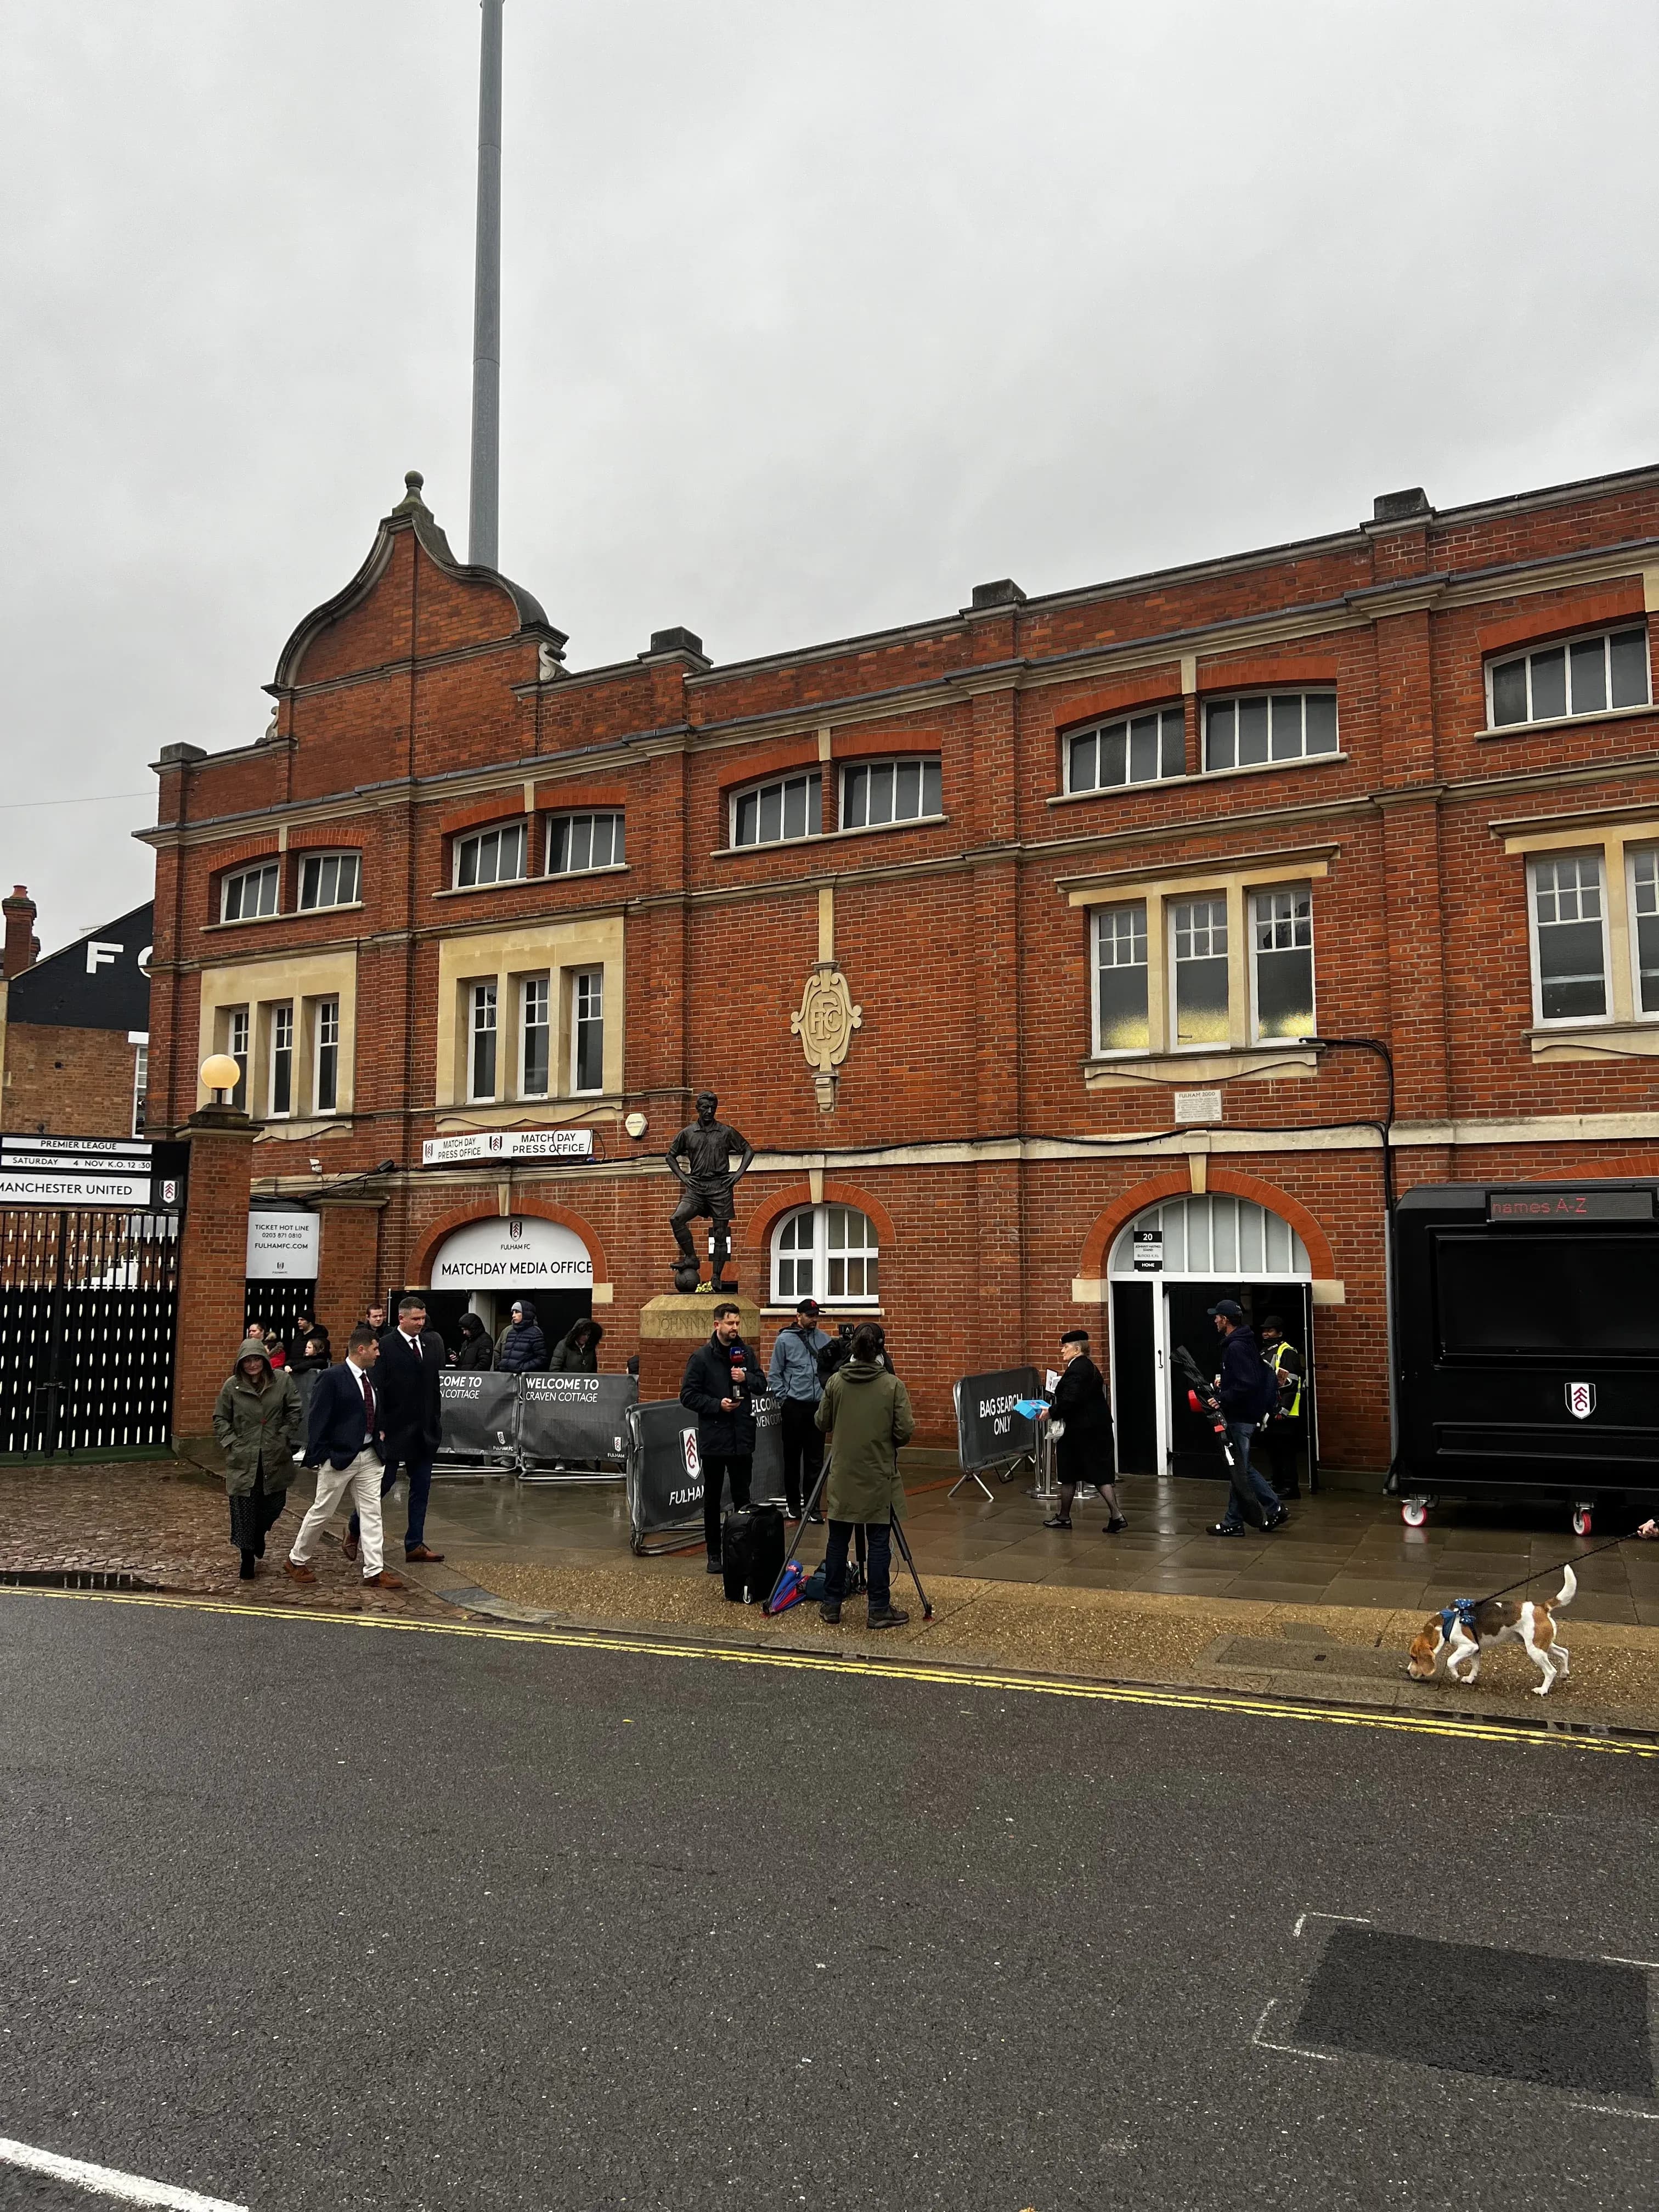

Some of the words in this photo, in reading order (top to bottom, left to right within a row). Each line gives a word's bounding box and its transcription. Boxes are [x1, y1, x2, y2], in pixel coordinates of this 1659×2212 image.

[443, 1138, 462, 1149] MATCH
[464, 1137, 476, 1147] DAY
[521, 1134, 553, 1143] MATCH
[557, 1133, 576, 1142] DAY
[41, 1140, 79, 1148] PREMIER
[512, 1144, 546, 1153] PRESS
[549, 1143, 585, 1152] OFFICE
[438, 1150, 458, 1159] PRESS
[460, 1147, 481, 1158] OFFICE
[13, 1157, 58, 1165] SATURDAY
[86, 1185, 132, 1195] UNITED
[1555, 1198, 1587, 1213] A-Z
[442, 1263, 507, 1276] MATCHDAY
[510, 1262, 548, 1274] MEDIA
[550, 1261, 593, 1273] OFFICE
[658, 1317, 710, 1331] JOHNNY
[469, 1376, 482, 1387] TO
[526, 1378, 580, 1390] WELCOME
[583, 1379, 599, 1390] TO
[445, 1389, 480, 1399] COTTAGE
[526, 1391, 556, 1401] CRAVEN
[558, 1392, 598, 1402] COTTAGE
[980, 1398, 996, 1418] BAG
[994, 1414, 1012, 1436] ONLY
